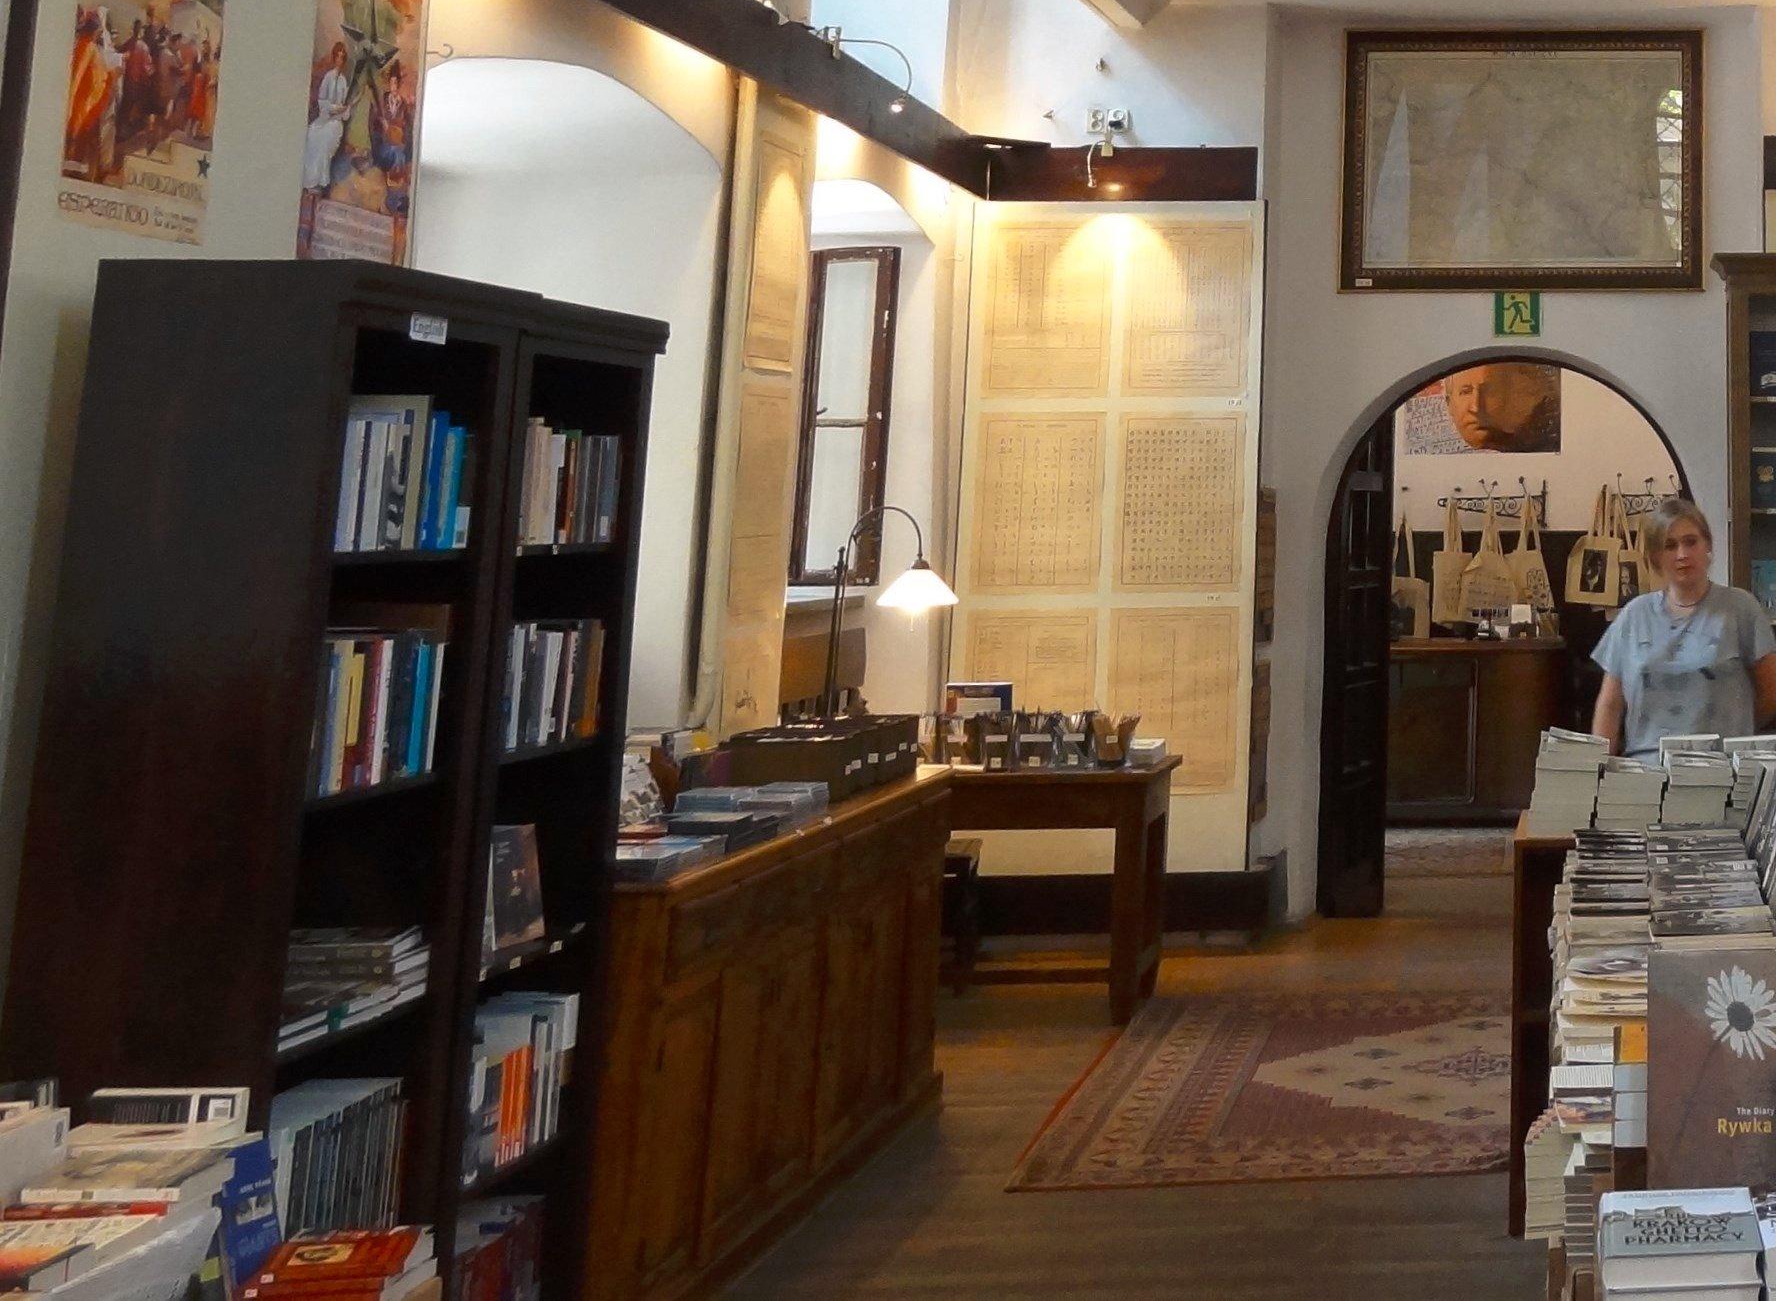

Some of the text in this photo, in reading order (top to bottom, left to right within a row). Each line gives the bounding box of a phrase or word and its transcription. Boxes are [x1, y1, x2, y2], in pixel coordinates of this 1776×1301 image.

[1736, 1107, 1751, 1115] The
[1753, 1107, 1775, 1116] Diary
[1717, 1118, 1773, 1137] Rywka
[1624, 1232, 1744, 1245] PHARMACY
